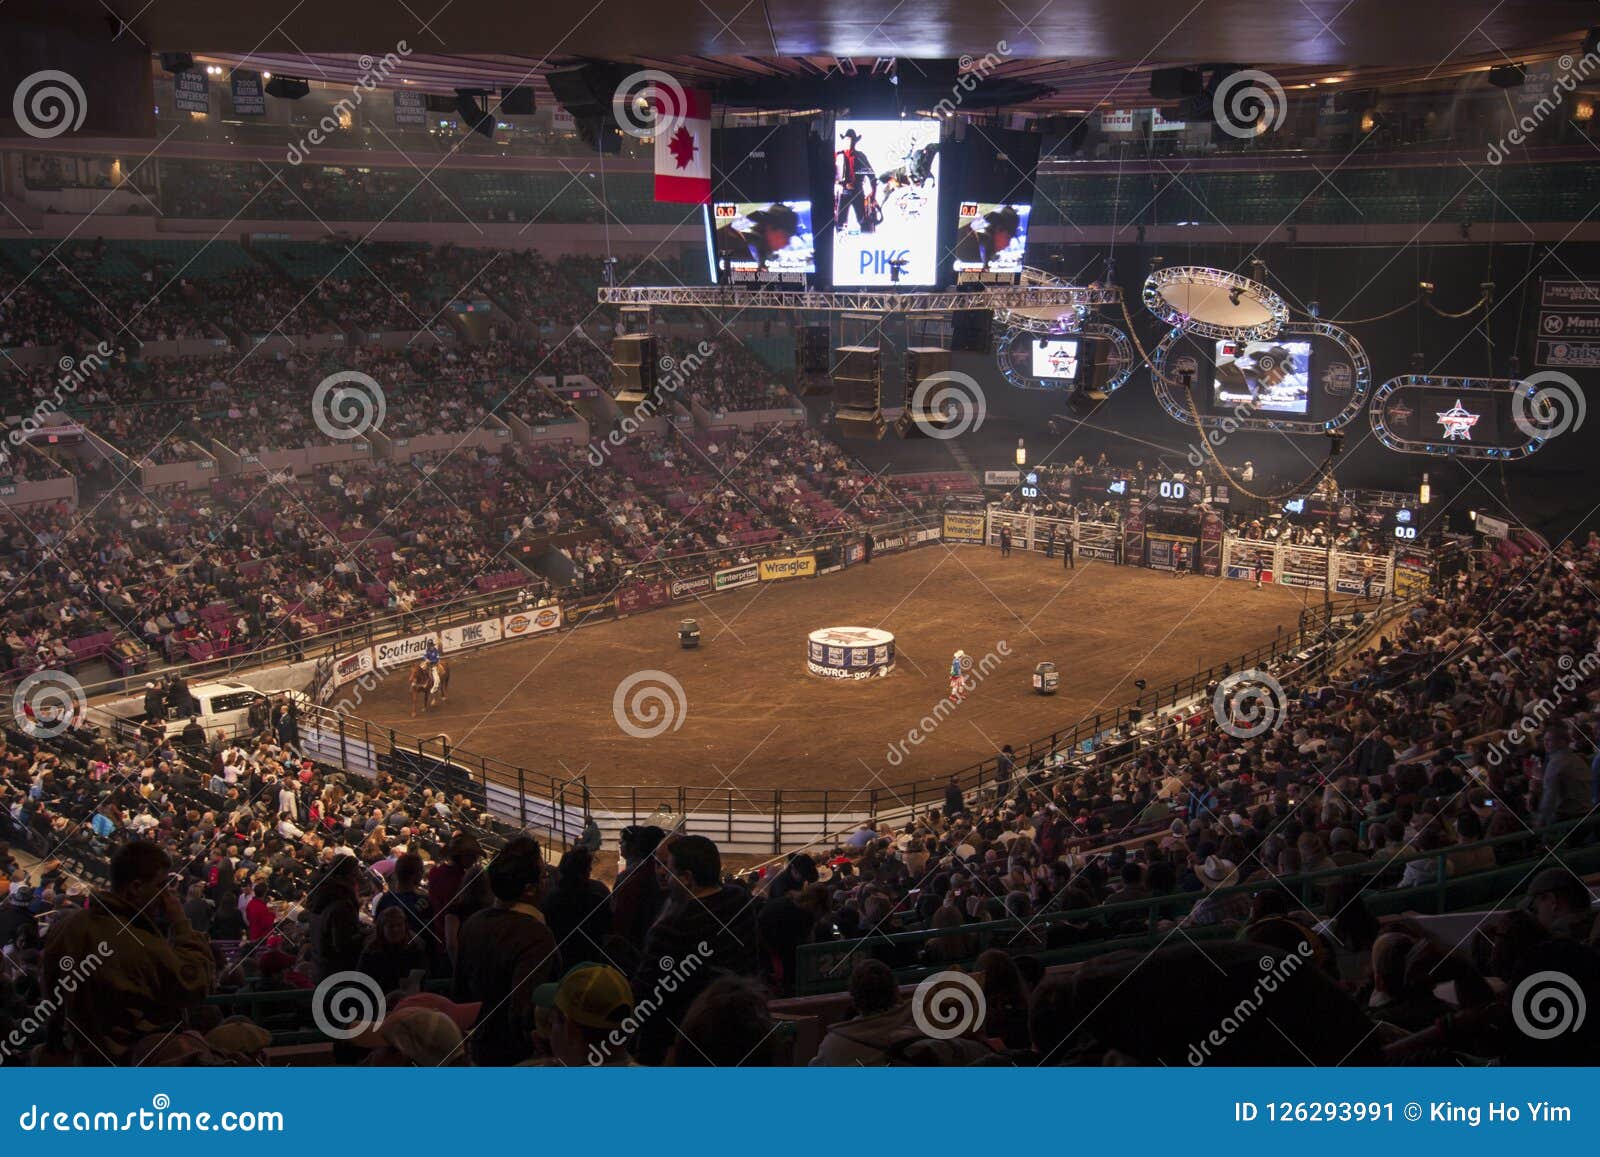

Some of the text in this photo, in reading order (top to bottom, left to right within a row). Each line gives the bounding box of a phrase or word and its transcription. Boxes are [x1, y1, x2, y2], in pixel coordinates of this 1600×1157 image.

[860, 249, 910, 275] PIKE
[1022, 487, 1037, 497] 0.0
[1160, 481, 1185, 499] 0.0
[1395, 526, 1416, 538] 0.0
[765, 560, 811, 576] Wrangler
[718, 569, 757, 584] enterprise
[462, 624, 483, 641] PIKE
